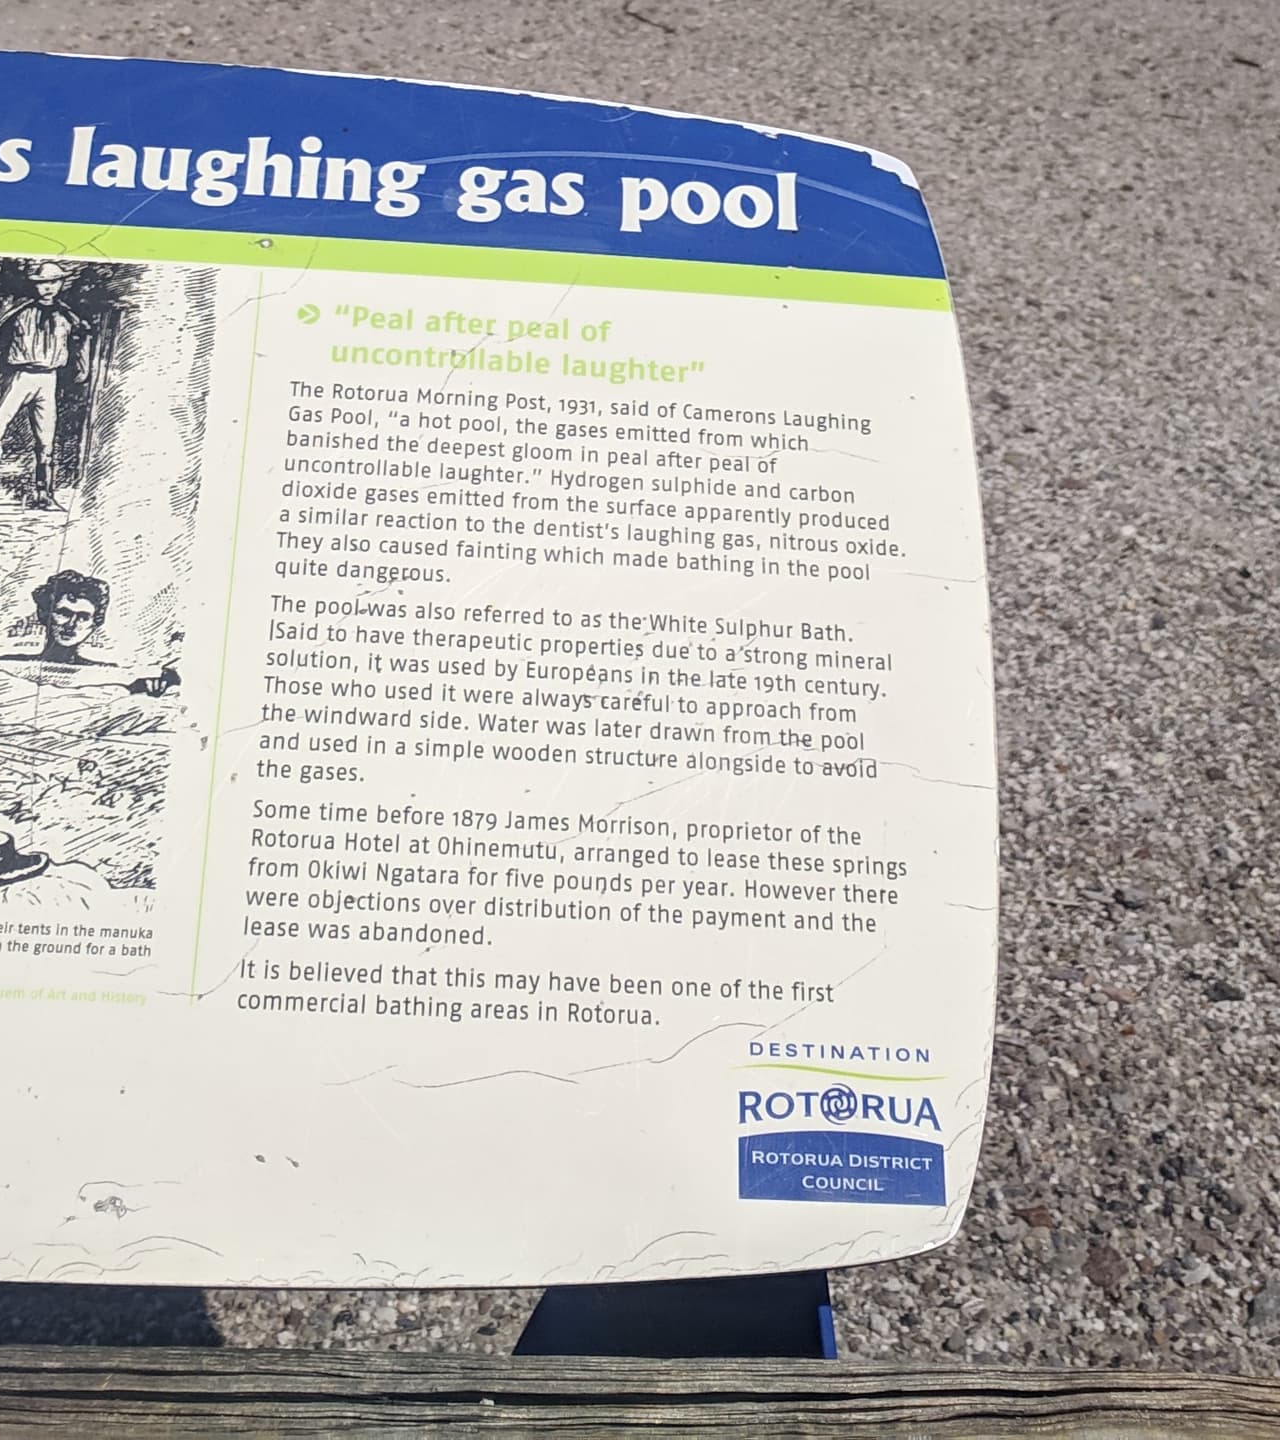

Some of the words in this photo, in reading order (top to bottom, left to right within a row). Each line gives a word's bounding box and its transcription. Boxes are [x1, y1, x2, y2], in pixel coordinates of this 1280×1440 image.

[65, 126, 426, 218] laughing
[456, 166, 585, 223] gas
[620, 172, 798, 232] pool
[423, 310, 496, 335] after
[506, 318, 570, 341] peal
[579, 319, 611, 342] of
[329, 345, 550, 373] uncontrollable
[289, 380, 324, 398] The
[331, 382, 408, 402] Rotorua
[416, 388, 498, 411] Morning
[505, 392, 551, 413] Post,
[558, 398, 602, 416] 1931,
[609, 399, 649, 416] said
[656, 402, 677, 418] of
[682, 403, 776, 424] Camerons
[783, 410, 871, 435] Laughing
[286, 429, 379, 450] banished
[386, 435, 419, 453] the
[426, 437, 505, 458] deepest
[511, 442, 572, 462] gloom
[580, 445, 598, 463] in
[607, 449, 647, 467] peal
[655, 450, 702, 469] after
[709, 455, 749, 473] peal
[757, 453, 778, 473] of
[284, 458, 431, 478] uncontrollable
[550, 469, 643, 493] Hydrogen
[651, 476, 736, 496] sulphide
[744, 482, 780, 499] and
[788, 485, 855, 503] carbon
[281, 480, 357, 500] dioxide
[364, 487, 419, 505] gases
[426, 489, 504, 507] emitted
[511, 491, 558, 510] from
[565, 495, 598, 513] the
[605, 498, 676, 517] surface
[684, 505, 791, 528] apparently
[798, 511, 889, 531] produced
[278, 508, 290, 522] a
[297, 506, 368, 525] similar
[375, 512, 457, 530] reaction
[464, 515, 485, 532] to
[491, 516, 525, 534] the
[627, 523, 715, 549] laughing
[721, 532, 760, 550] gas,
[769, 532, 838, 552] nitrous
[845, 538, 906, 557] oxide.
[265, 649, 358, 672] solution,
[367, 652, 382, 673] it
[389, 657, 429, 673] was
[437, 658, 485, 676] used
[494, 658, 518, 682] by
[525, 660, 633, 685] Europeans
[667, 668, 704, 687] the
[709, 669, 747, 689] late
[753, 673, 796, 693] 19th
[804, 678, 886, 701] century.
[256, 759, 291, 778] the
[299, 764, 364, 783] gases.
[258, 732, 299, 750] and
[308, 734, 358, 753] used
[366, 735, 386, 754] in
[394, 740, 406, 755] a
[414, 738, 484, 761] simple
[491, 743, 576, 763] wooden
[585, 747, 677, 768] structure
[685, 751, 786, 775] alongside
[792, 757, 814, 775] to
[822, 757, 877, 778] avoid
[252, 799, 310, 820] Some
[318, 802, 367, 822] time
[376, 804, 444, 826] before
[452, 809, 497, 831] 1879
[504, 810, 569, 831] James
[578, 814, 677, 839] Morrison,
[686, 821, 792, 843] proprietor
[799, 824, 821, 843] of
[826, 825, 861, 845] the
[251, 828, 335, 850] Rotorua
[344, 832, 400, 852] Hotel
[408, 836, 430, 854] at
[437, 836, 564, 863] Ohinemutu,
[573, 846, 669, 868] arranged
[676, 847, 698, 866] to
[707, 847, 760, 869] lease
[766, 851, 824, 872] these
[832, 855, 907, 880] springs
[17, 923, 51, 935] tents
[55, 923, 68, 936] in
[72, 924, 95, 937] the
[99, 927, 153, 939] manuka
[243, 917, 299, 937] lease
[307, 922, 350, 939] was
[358, 922, 492, 945] abandoned.
[245, 890, 299, 907] were
[307, 890, 420, 913] objections
[428, 898, 476, 916] over
[483, 897, 610, 920] distribution
[619, 902, 642, 922] of
[647, 904, 682, 924] the
[691, 909, 786, 930] payment
[793, 911, 833, 930] and
[841, 912, 876, 932] the
[6, 939, 29, 952] the
[32, 941, 82, 955] ground
[85, 941, 105, 955] for
[107, 945, 116, 955] a
[120, 943, 151, 956] bath
[236, 993, 366, 1013] commercial
[375, 995, 462, 1022] bathing
[470, 1002, 529, 1020] areas
[537, 1000, 557, 1021] in
[567, 1002, 659, 1025] Rotorua.
[749, 1041, 930, 1063] DESTINATION
[738, 1082, 942, 1132] ROTORUA
[751, 1150, 843, 1168] ROTORUA
[849, 1153, 932, 1171] DISTRICT
[802, 1175, 885, 1192] COUNCIL
